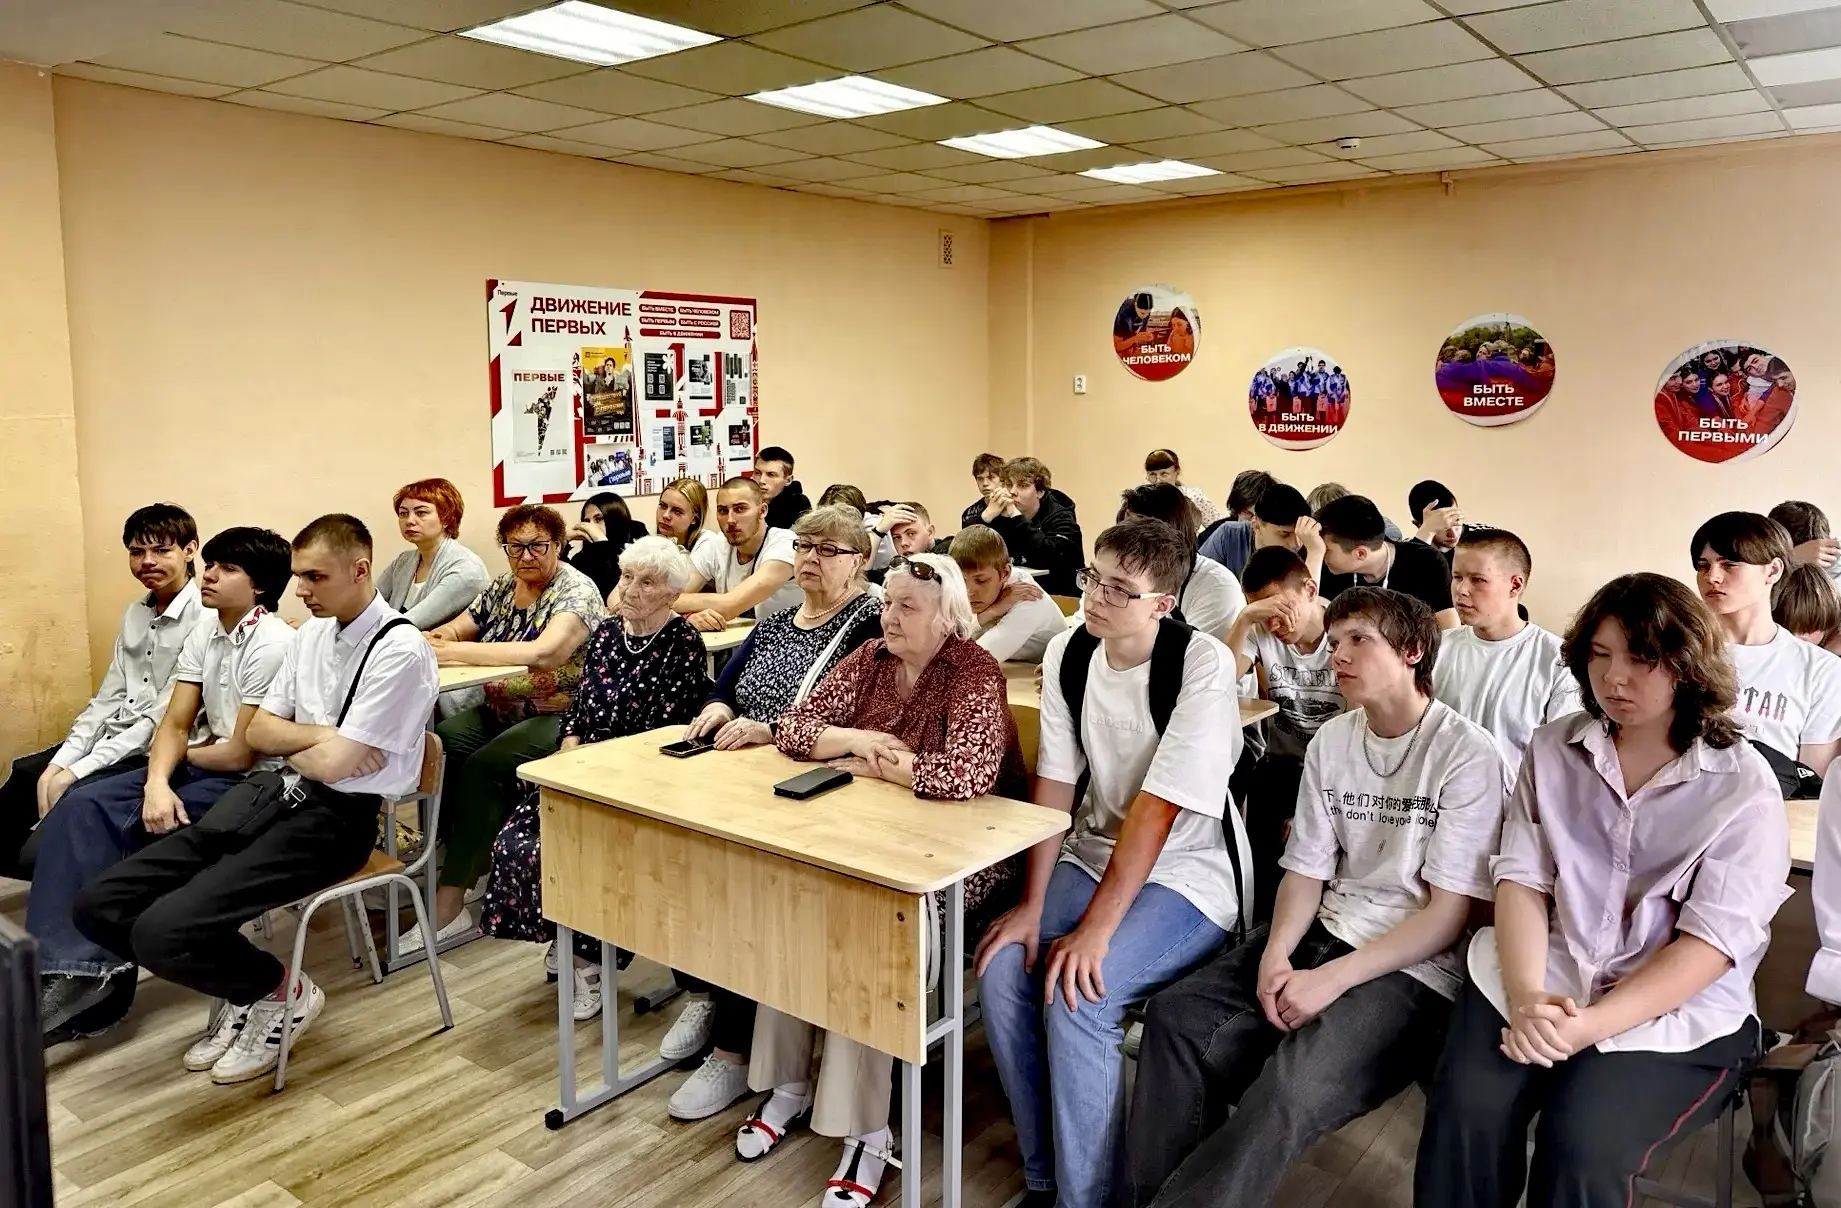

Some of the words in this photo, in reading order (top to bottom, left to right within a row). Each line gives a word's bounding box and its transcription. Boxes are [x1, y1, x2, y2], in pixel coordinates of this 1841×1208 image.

[530, 296, 632, 316] ДВИЖЕНИЕ
[531, 318, 606, 335] ПЕРВЫХ
[1141, 344, 1172, 353] БЫТЬ
[1123, 353, 1191, 365] ЧЕЛОВЕКОМ
[513, 373, 565, 382] ПЕРВЫЕ
[1473, 384, 1515, 394] БЫТЬ
[1463, 396, 1524, 406] ВМЕСТЕ
[1281, 412, 1315, 422] БЫТЬ
[1699, 417, 1749, 429] БЫТЬ
[1258, 423, 1266, 432] В
[1268, 424, 1338, 433] ДВИЖЕНИИ
[1678, 430, 1769, 444] ПЕРВЫМИ
[1270, 663, 1340, 687] SUPREM
[1737, 686, 1788, 722] TAR
[1346, 810, 1374, 822] don't
